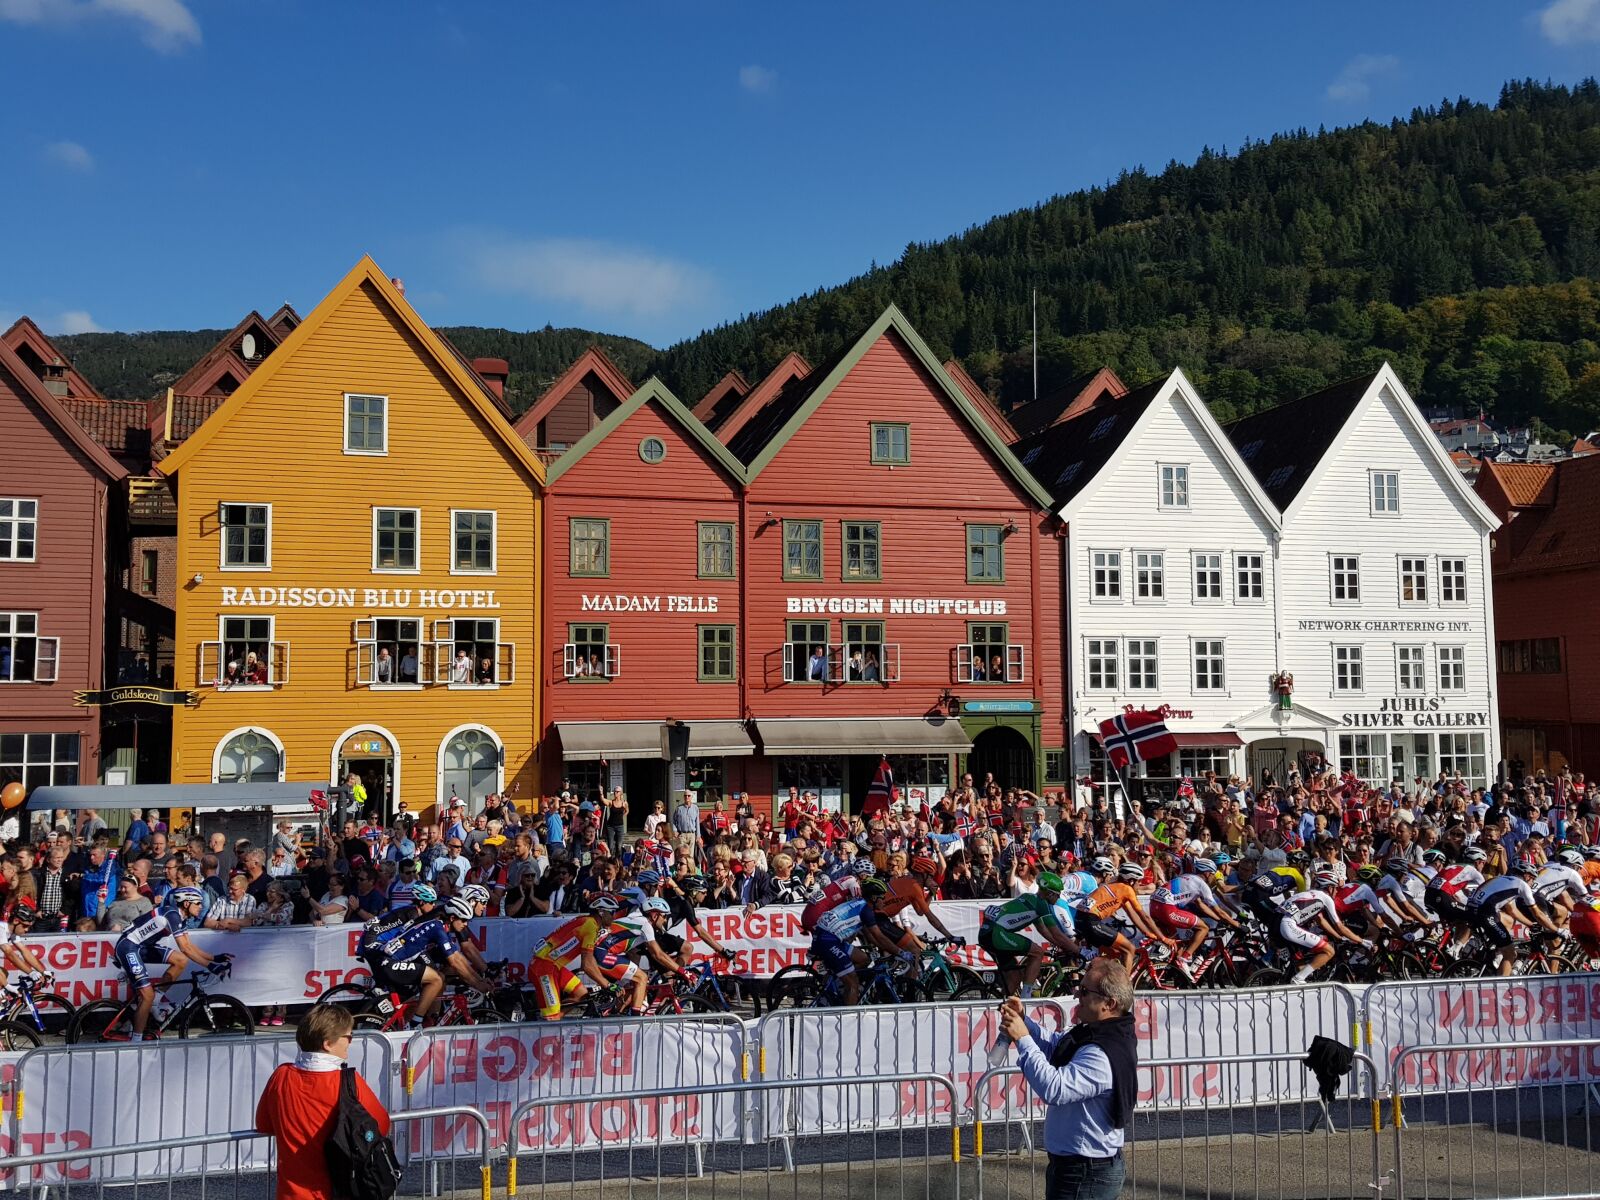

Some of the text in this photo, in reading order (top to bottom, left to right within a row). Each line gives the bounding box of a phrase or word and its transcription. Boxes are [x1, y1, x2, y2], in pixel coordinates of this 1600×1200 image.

[220, 587, 501, 608] RADISSON BLU HOTEL
[581, 594, 719, 612] MADAM FELLE
[786, 597, 1007, 615] BRYGGEN NIGHTCLUB
[1299, 621, 1472, 632] NETWORK CHARTERING INT.
[111, 689, 159, 701] Guldskoen
[1342, 713, 1488, 727] SILVER GALLERY
[138, 921, 159, 939] FRANCE
